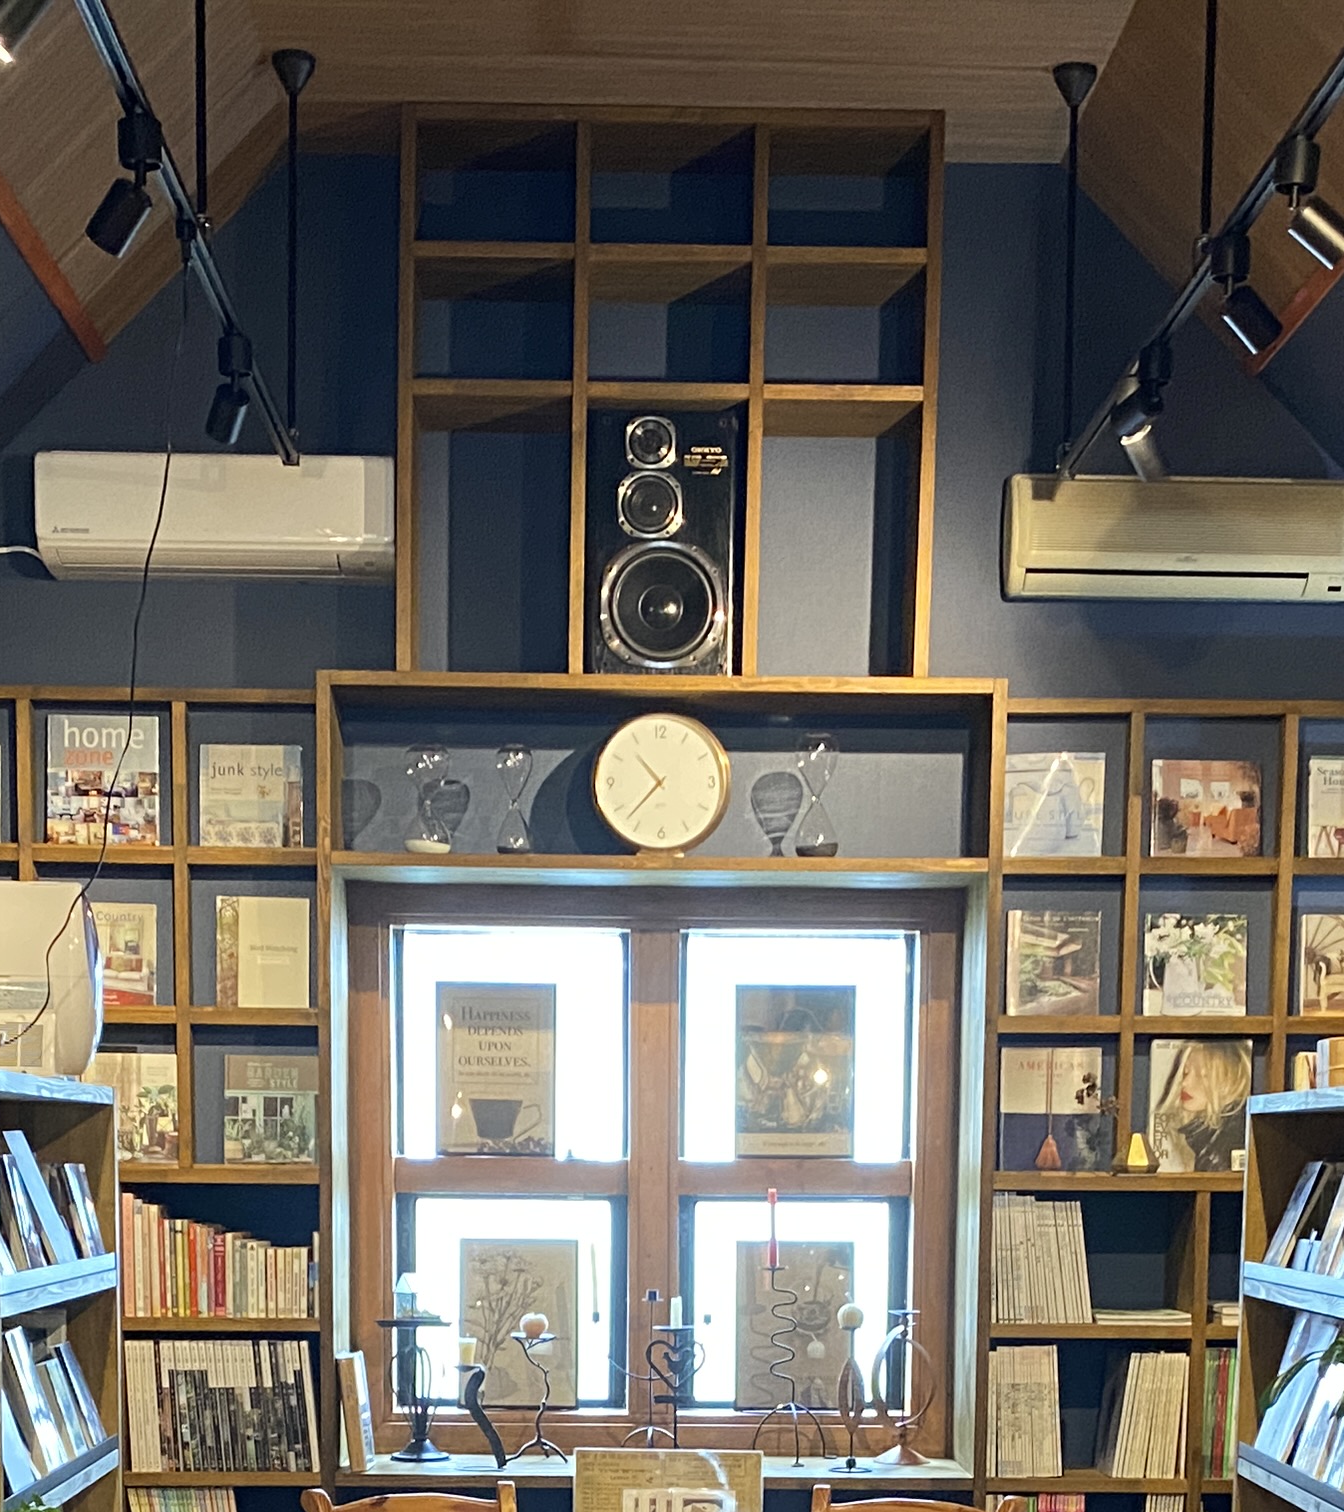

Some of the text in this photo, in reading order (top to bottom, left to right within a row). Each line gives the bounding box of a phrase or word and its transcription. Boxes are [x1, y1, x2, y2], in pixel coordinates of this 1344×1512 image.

[690, 446, 723, 454] ONKYO
[63, 718, 145, 749] home
[655, 725, 667, 739] 12
[63, 749, 114, 766] zone
[210, 762, 283, 780] junk style
[606, 776, 615, 790] 9
[708, 775, 716, 789] 3
[656, 827, 666, 840] 6
[96, 910, 144, 923] Country
[468, 1025, 523, 1036] DEPENDS
[478, 1040, 512, 1052] UPON
[269, 1078, 298, 1089] STYLE
